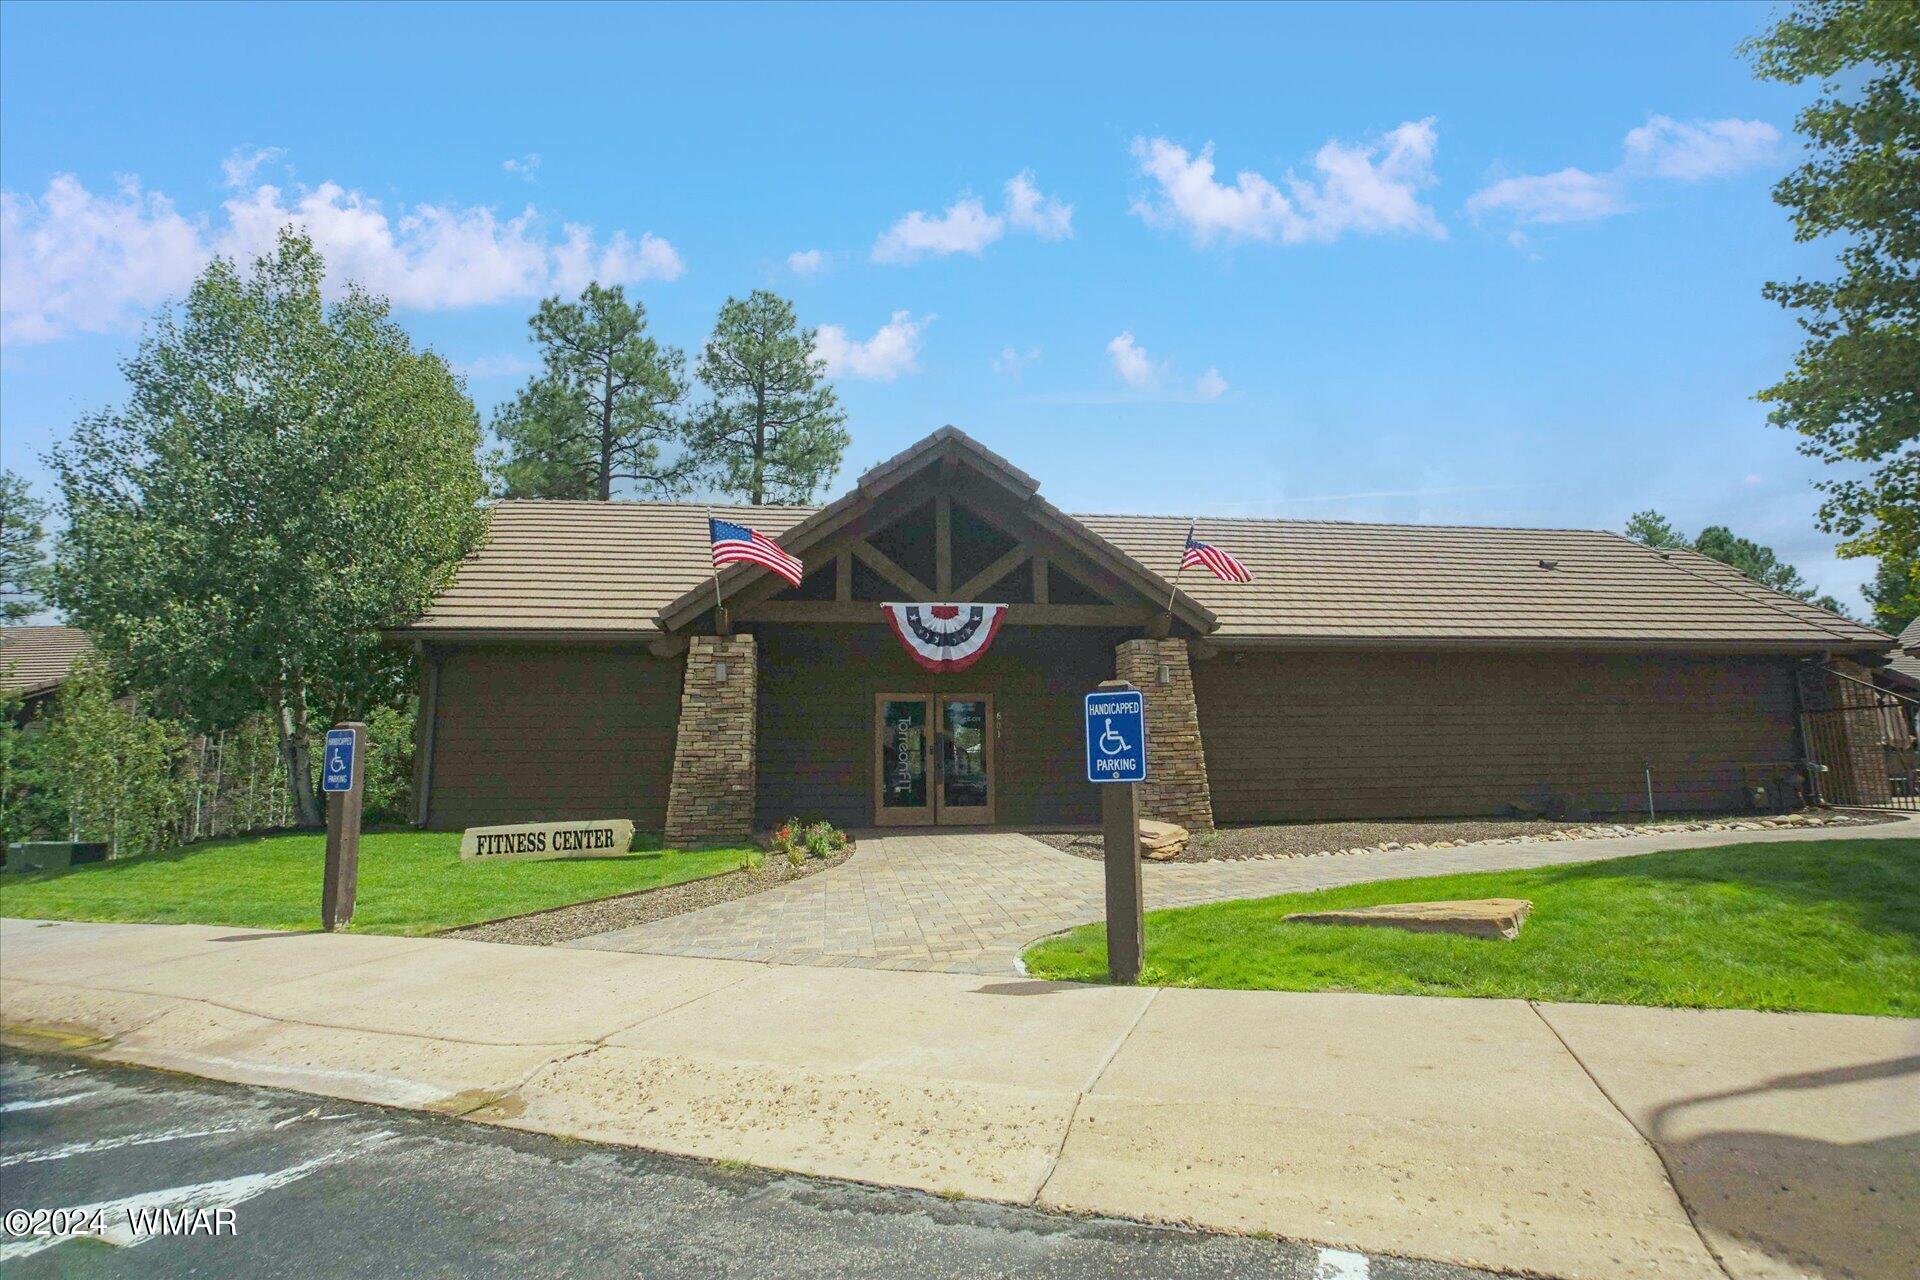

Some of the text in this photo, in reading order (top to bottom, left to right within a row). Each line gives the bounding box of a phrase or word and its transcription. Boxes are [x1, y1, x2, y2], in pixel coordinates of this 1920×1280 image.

[1089, 702, 1140, 715] HANDICAPPED
[1096, 758, 1136, 771] PARKING
[476, 828, 615, 855] FITNESS CENTER
